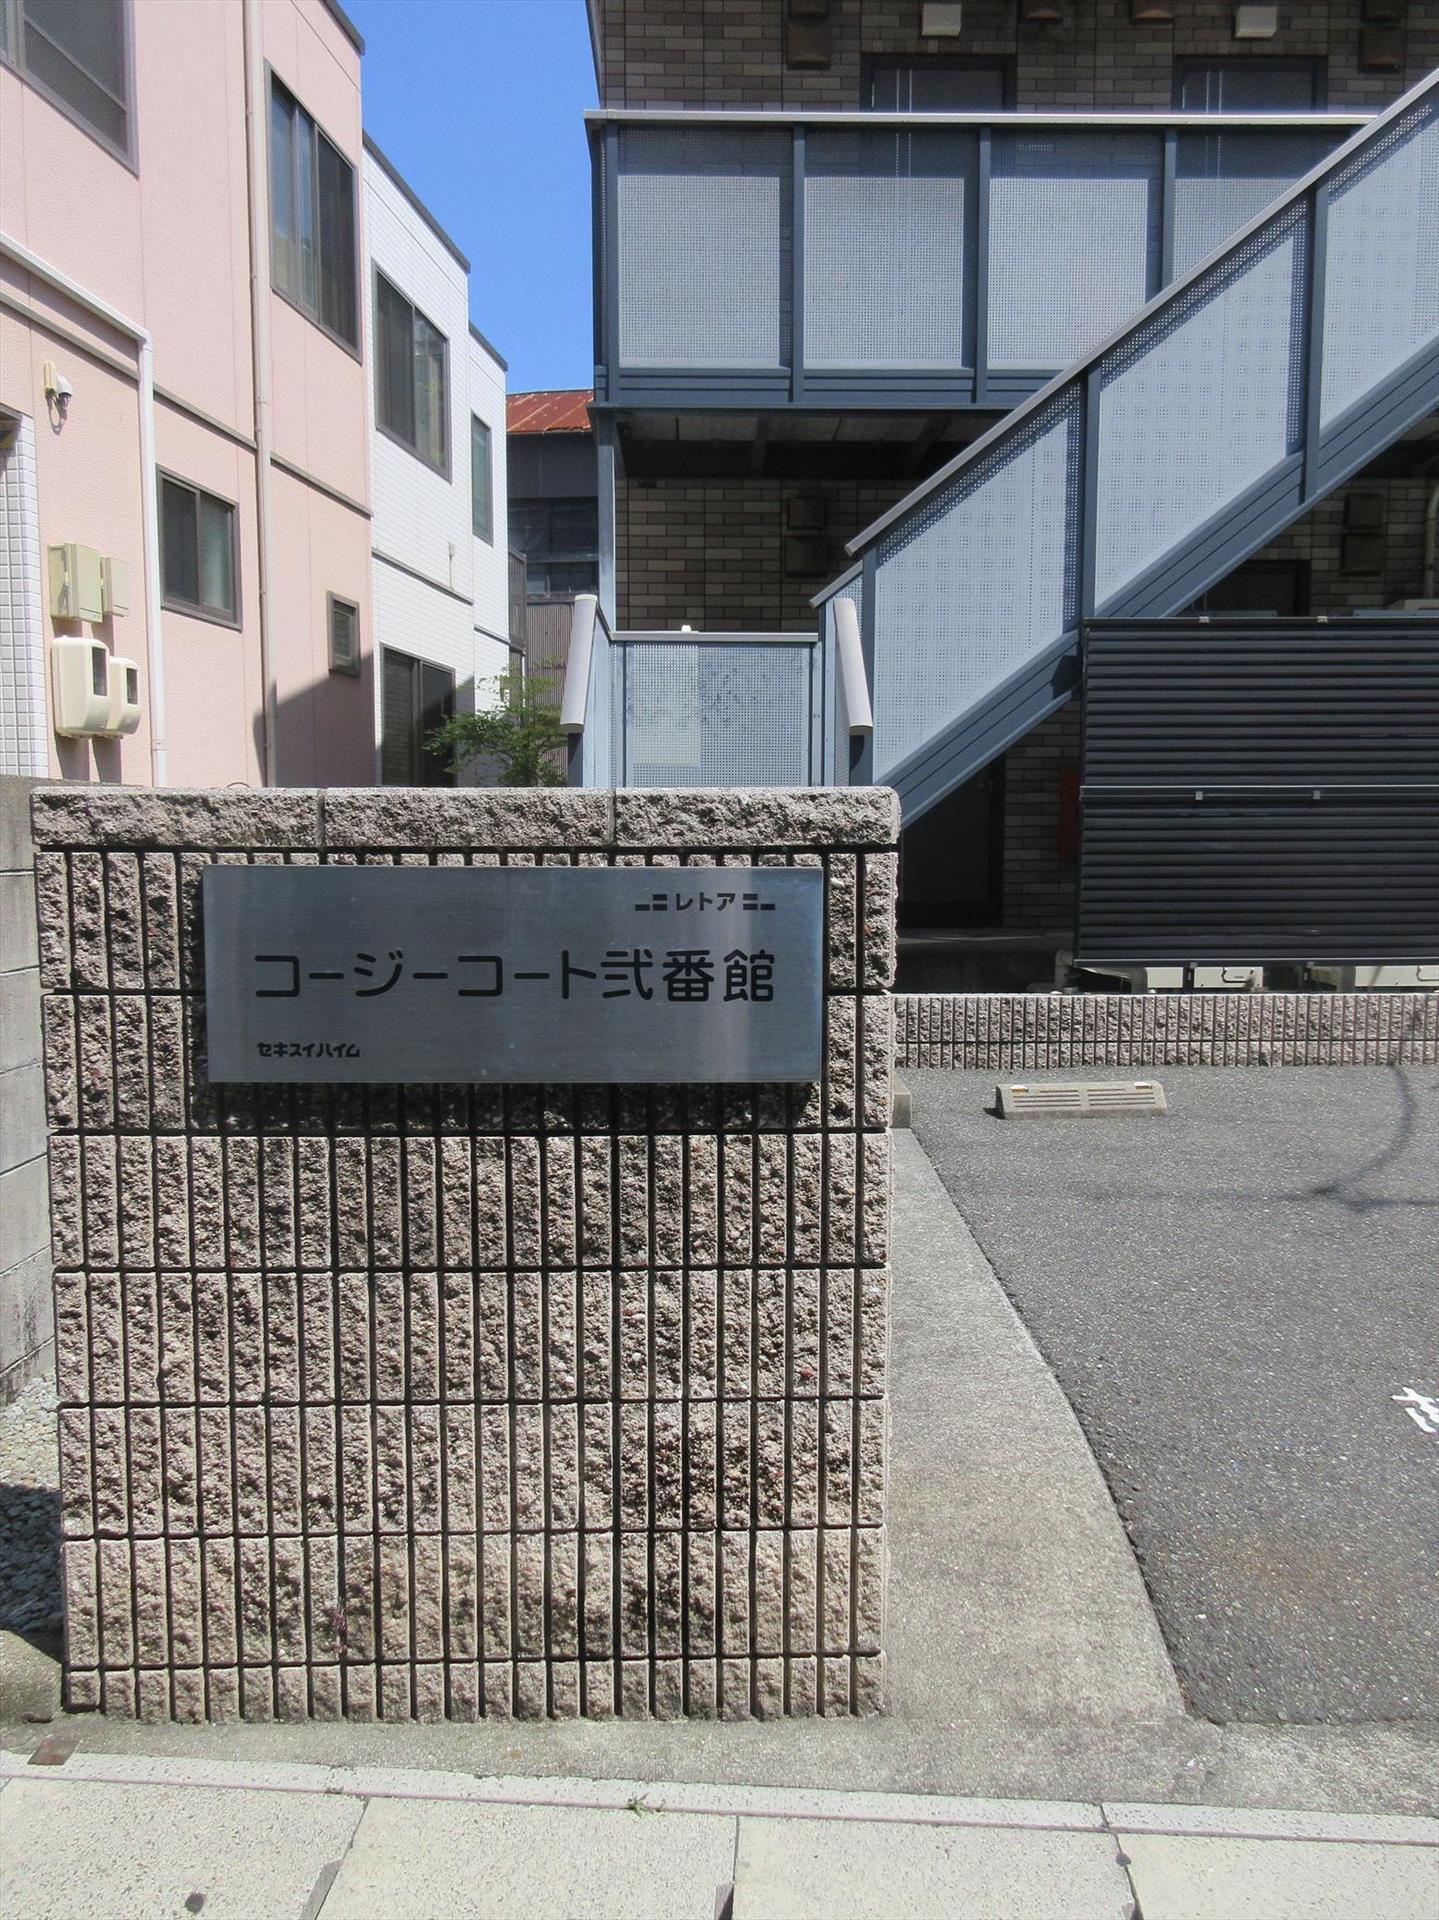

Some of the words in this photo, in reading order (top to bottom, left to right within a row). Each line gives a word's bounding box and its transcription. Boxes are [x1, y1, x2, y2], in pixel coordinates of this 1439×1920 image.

[676, 892, 736, 911] レトア
[254, 949, 775, 1002] コージーコート弐番館
[257, 1041, 360, 1058] セキスイハイム
